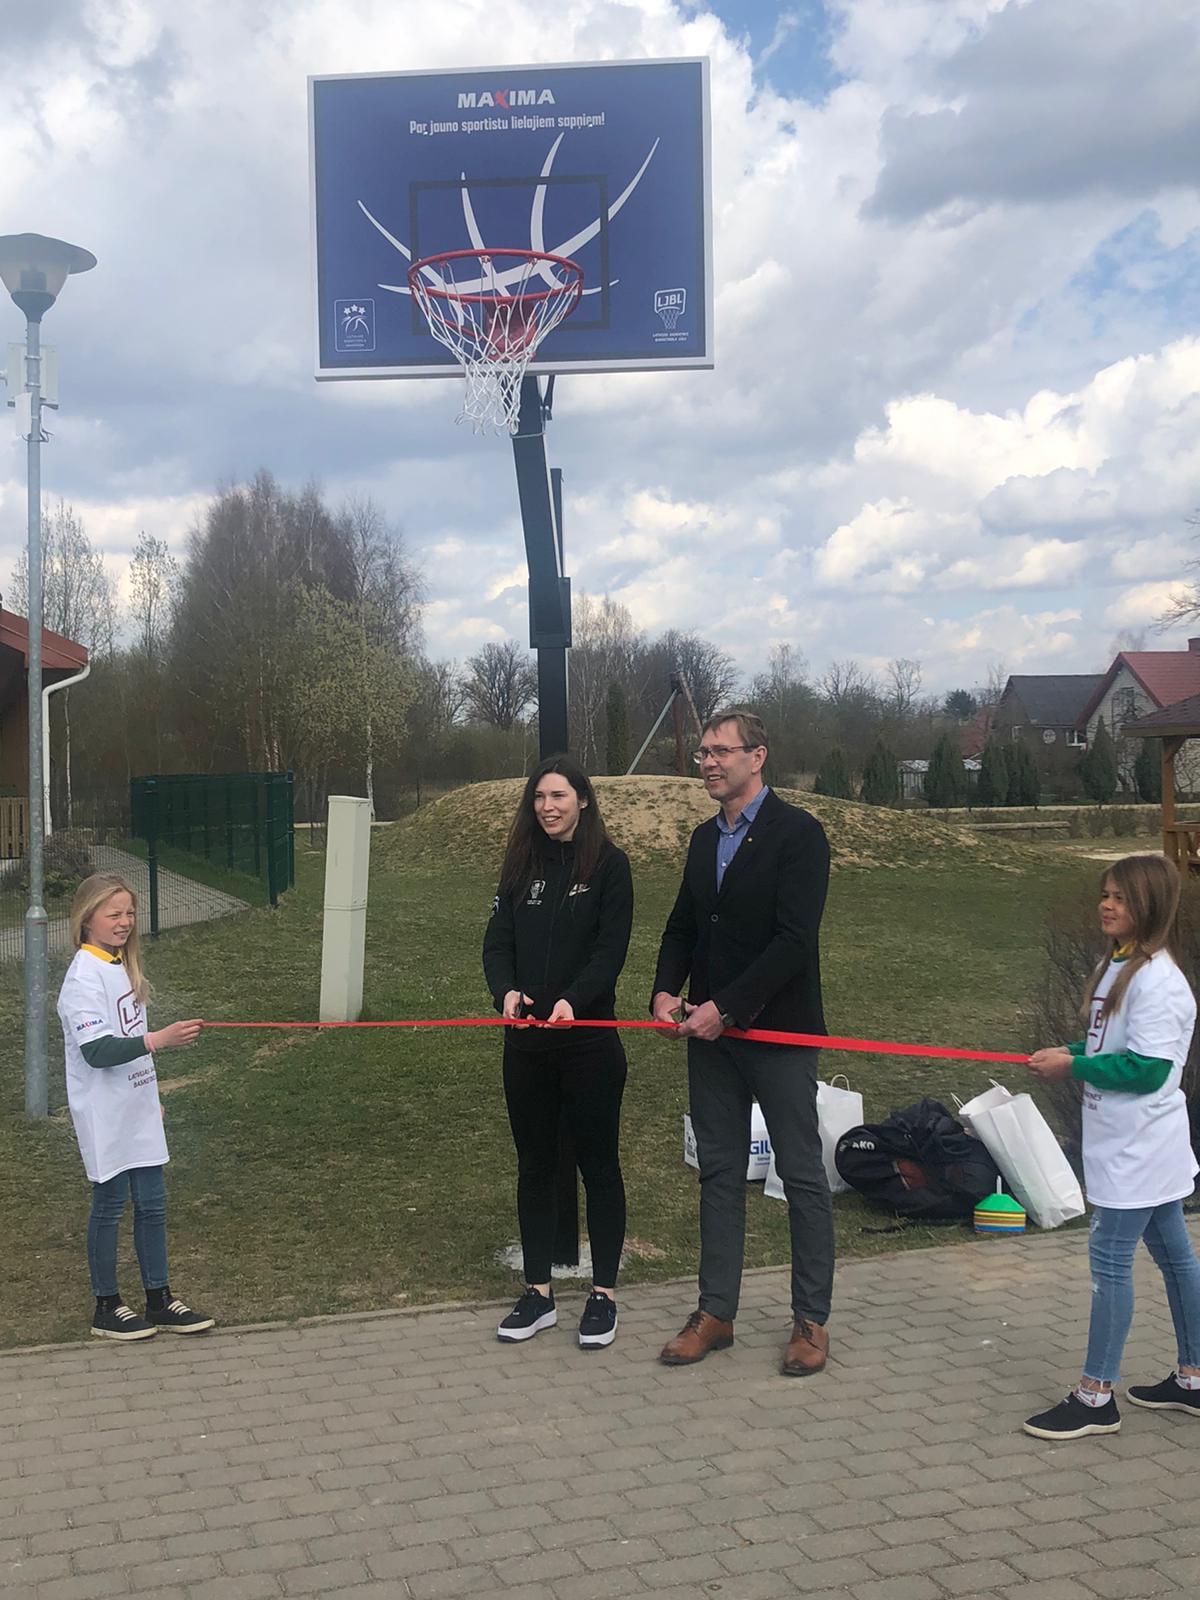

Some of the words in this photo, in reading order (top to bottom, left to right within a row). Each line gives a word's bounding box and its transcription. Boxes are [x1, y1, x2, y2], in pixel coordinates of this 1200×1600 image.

[458, 89, 556, 109] MAXIMA
[409, 120, 428, 134] Par
[430, 120, 458, 136] jauno
[461, 116, 508, 134] sportistu
[511, 115, 555, 131] lielajiem
[558, 112, 605, 130] sapņiem!
[657, 293, 683, 307] LJBL
[76, 1018, 104, 1032] MAXIMA
